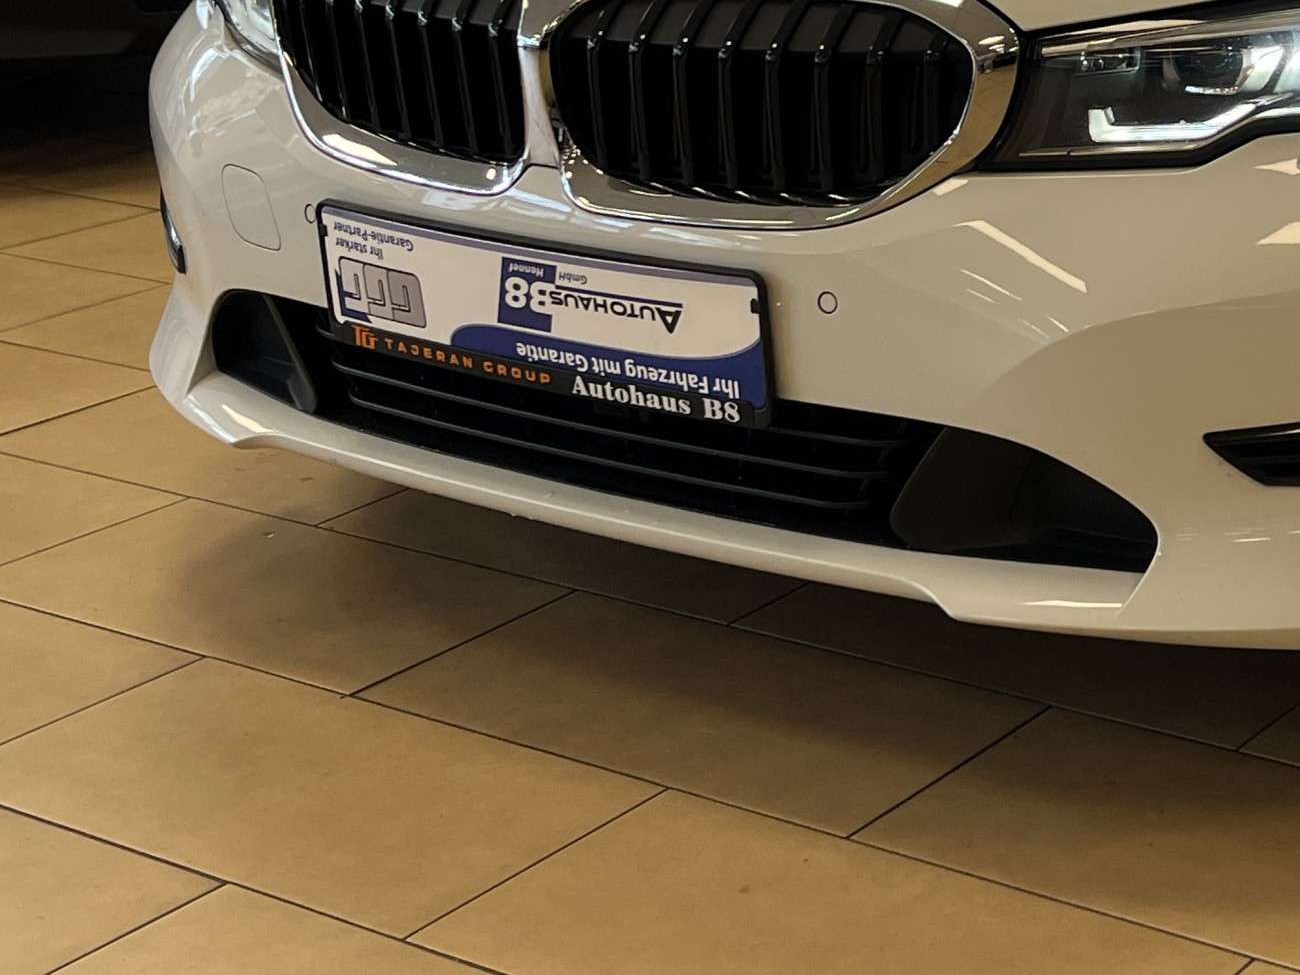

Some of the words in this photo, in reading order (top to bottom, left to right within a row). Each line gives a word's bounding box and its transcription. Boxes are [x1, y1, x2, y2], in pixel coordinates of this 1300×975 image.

[334, 221, 414, 251] Garantie-Partner
[335, 237, 368, 255] starker
[509, 262, 544, 277] Hennef
[558, 270, 587, 284] GmbH
[505, 277, 556, 315] B8
[384, 338, 473, 368] TAJERAN
[482, 357, 551, 384] GROUP
[516, 342, 588, 372] Garantie
[592, 356, 621, 376] mit
[624, 359, 708, 393] Fahrzeug
[713, 377, 739, 399] Ihr
[572, 375, 691, 415] Autohaus
[703, 397, 741, 423] B8
